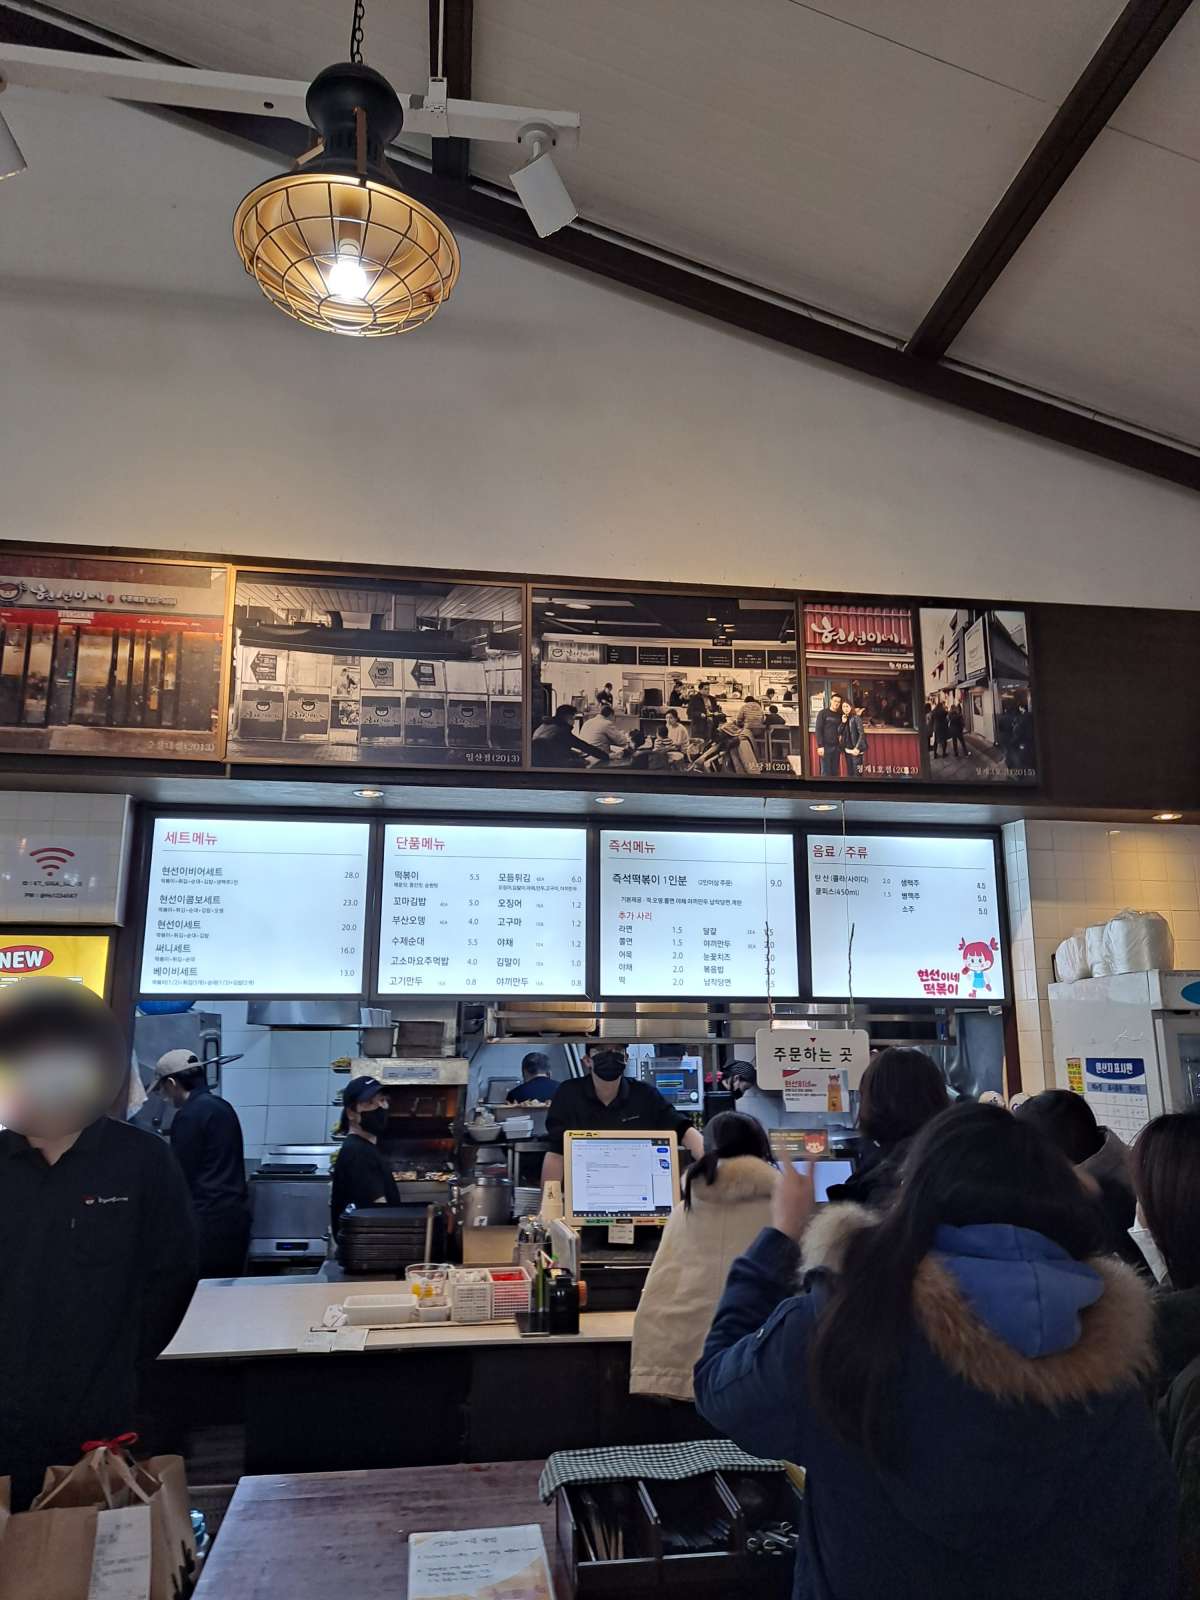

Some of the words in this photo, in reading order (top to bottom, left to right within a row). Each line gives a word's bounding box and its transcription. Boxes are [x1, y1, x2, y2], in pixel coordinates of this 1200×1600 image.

[811, 616, 899, 646] 현선이네
[164, 831, 218, 845] 세트메뉴
[396, 836, 445, 851] 단품메뉴
[608, 840, 656, 854] 즉석메뉴
[813, 845, 835, 858] 음료
[845, 846, 868, 859] 주류
[161, 866, 224, 877] 현선이비어세트
[394, 871, 419, 880] 떡볶이
[498, 873, 531, 883] 모듬튀김
[612, 873, 660, 885] 즉석떡볶이
[663, 875, 688, 886] 1인분
[770, 879, 782, 887] 9.0
[160, 894, 222, 905] 현선이콤보세트
[343, 899, 358, 907] 23.0
[393, 897, 426, 906] 꼬마김밥
[497, 899, 522, 908] 오징어
[618, 911, 634, 920] 추가
[636, 911, 652, 920] 사리
[157, 920, 201, 930] 현선이세트
[468, 918, 479, 926] 4.0
[497, 917, 522, 927] 고구마
[618, 925, 633, 934] 라면
[672, 926, 683, 934] 1.5
[392, 936, 425, 946] 수제순대
[496, 938, 514, 947] 야채
[672, 938, 683, 946] 1.5
[0, 951, 44, 969] NEW
[496, 957, 521, 967] 김말이
[153, 967, 198, 976] 베이비세트
[672, 965, 684, 973] 2.0
[389, 976, 424, 986] 고기만두
[917, 969, 960, 983] 현선이네
[672, 978, 684, 986] 2.0
[773, 1047, 832, 1062] 주문하는
[840, 1047, 852, 1062] 곳
